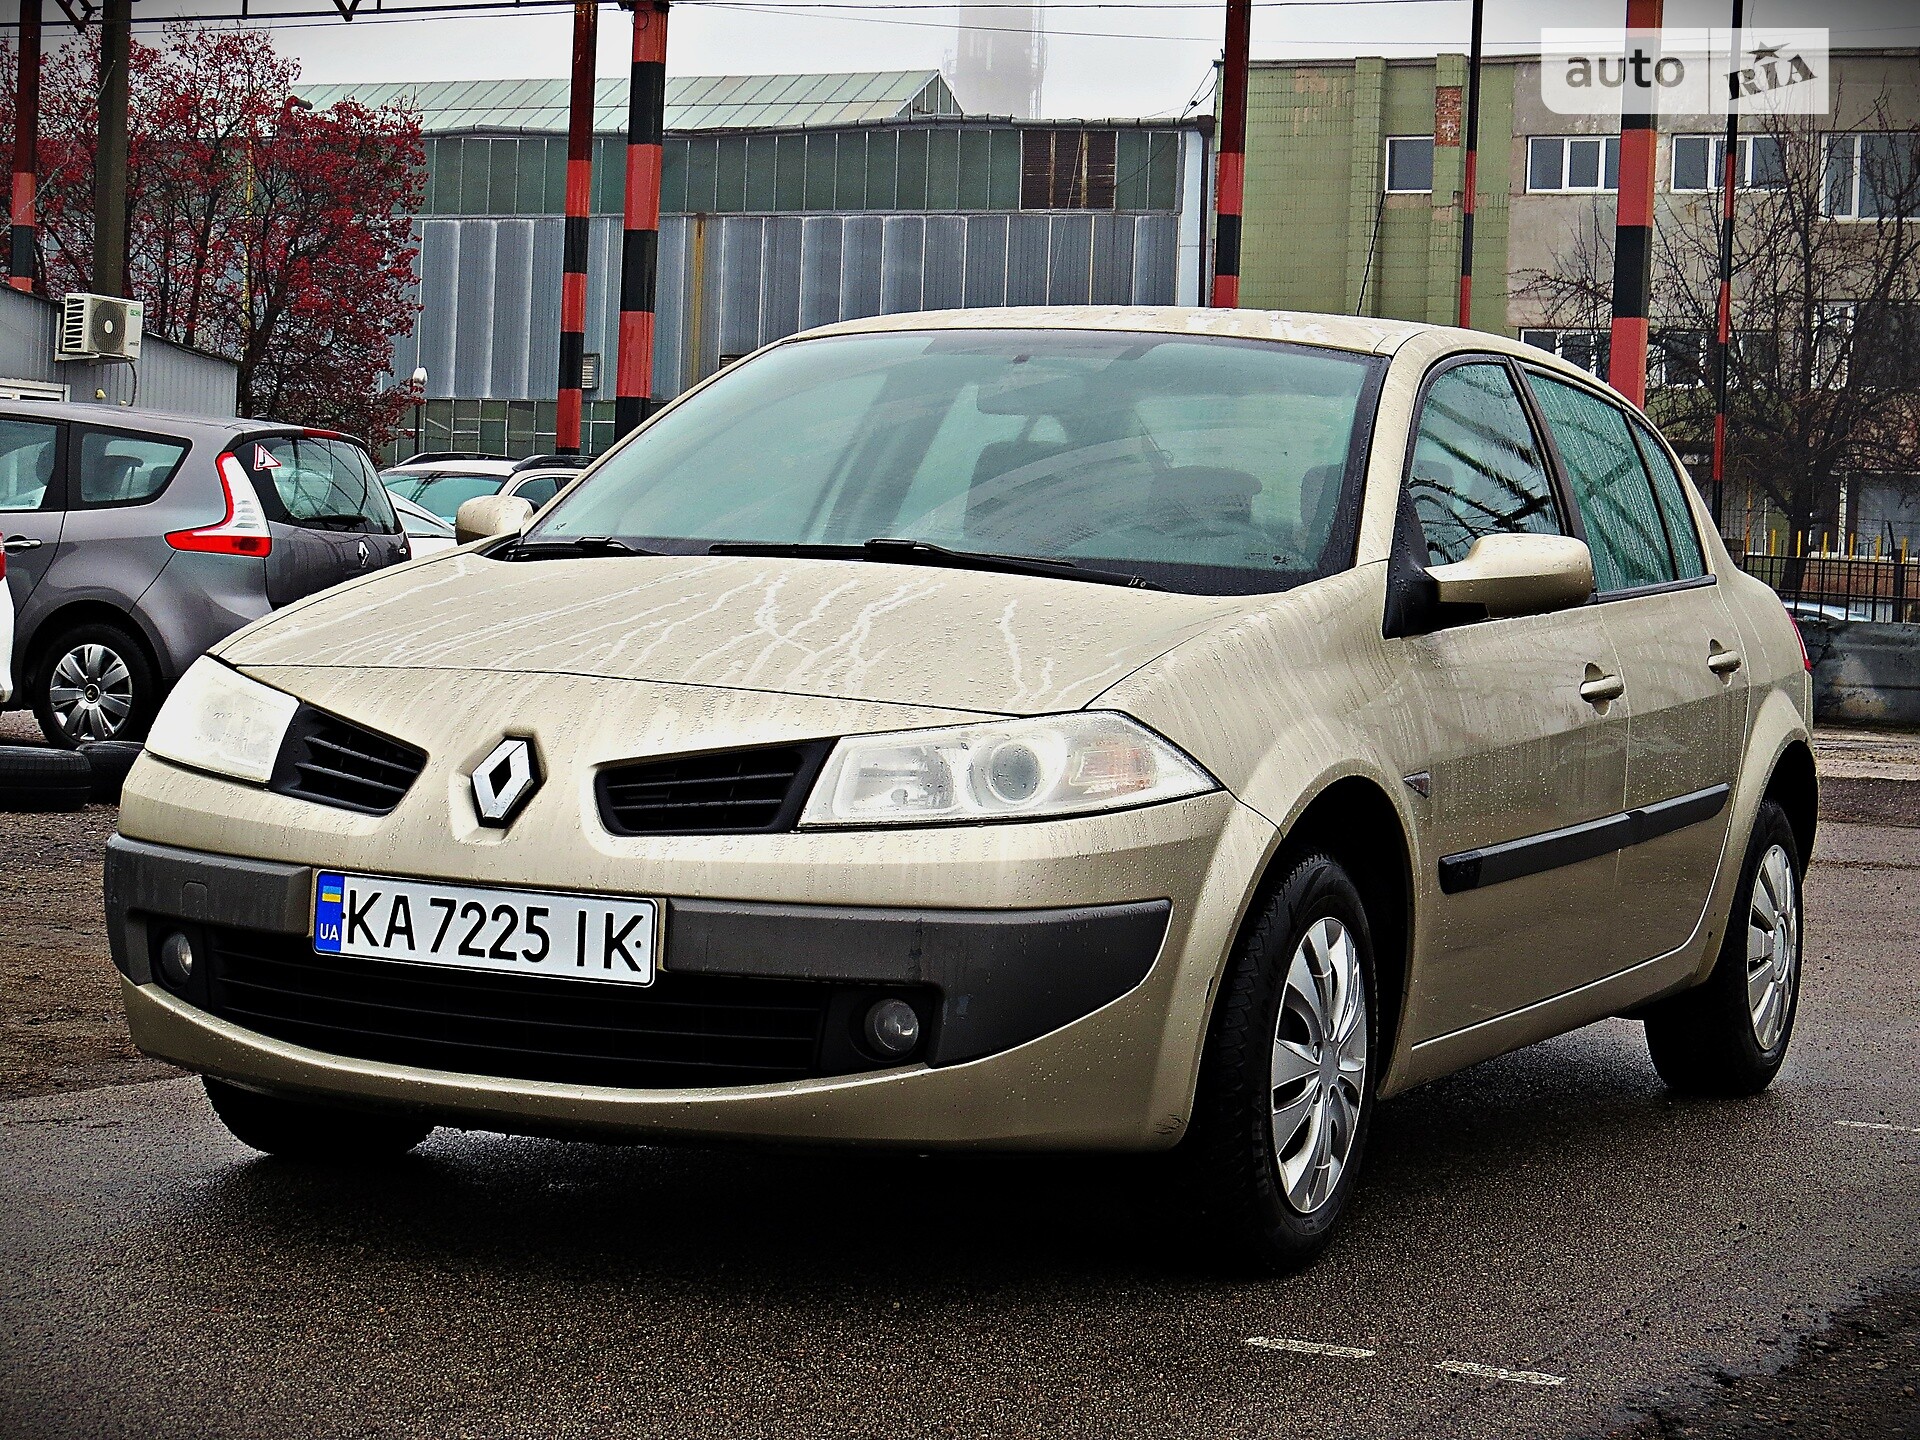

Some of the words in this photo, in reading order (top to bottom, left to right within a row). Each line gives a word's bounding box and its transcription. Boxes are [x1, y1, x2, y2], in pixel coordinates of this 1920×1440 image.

[319, 923, 339, 941] UA
[347, 889, 415, 951] KA
[429, 897, 550, 963] 7225
[576, 910, 644, 973] IK
